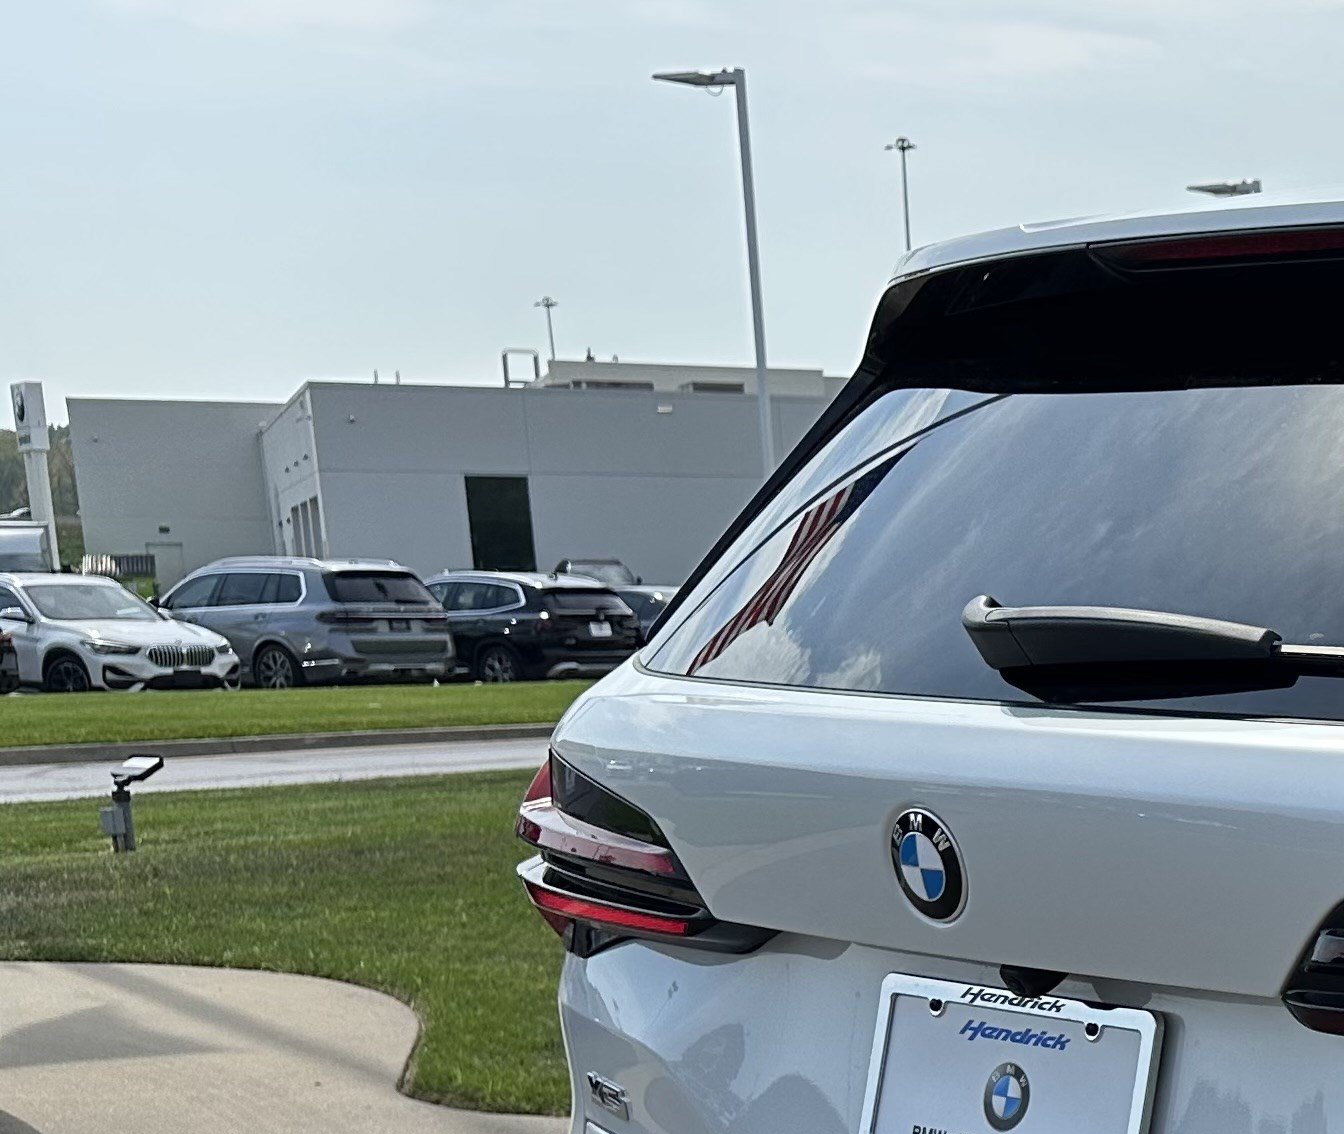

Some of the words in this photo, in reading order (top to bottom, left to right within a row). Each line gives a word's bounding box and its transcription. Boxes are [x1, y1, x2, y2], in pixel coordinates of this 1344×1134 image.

[892, 812, 951, 852] BMW
[960, 986, 1066, 1013] Hendrick
[959, 1019, 1071, 1051] Hendrick
[991, 1064, 1028, 1088] BMW
